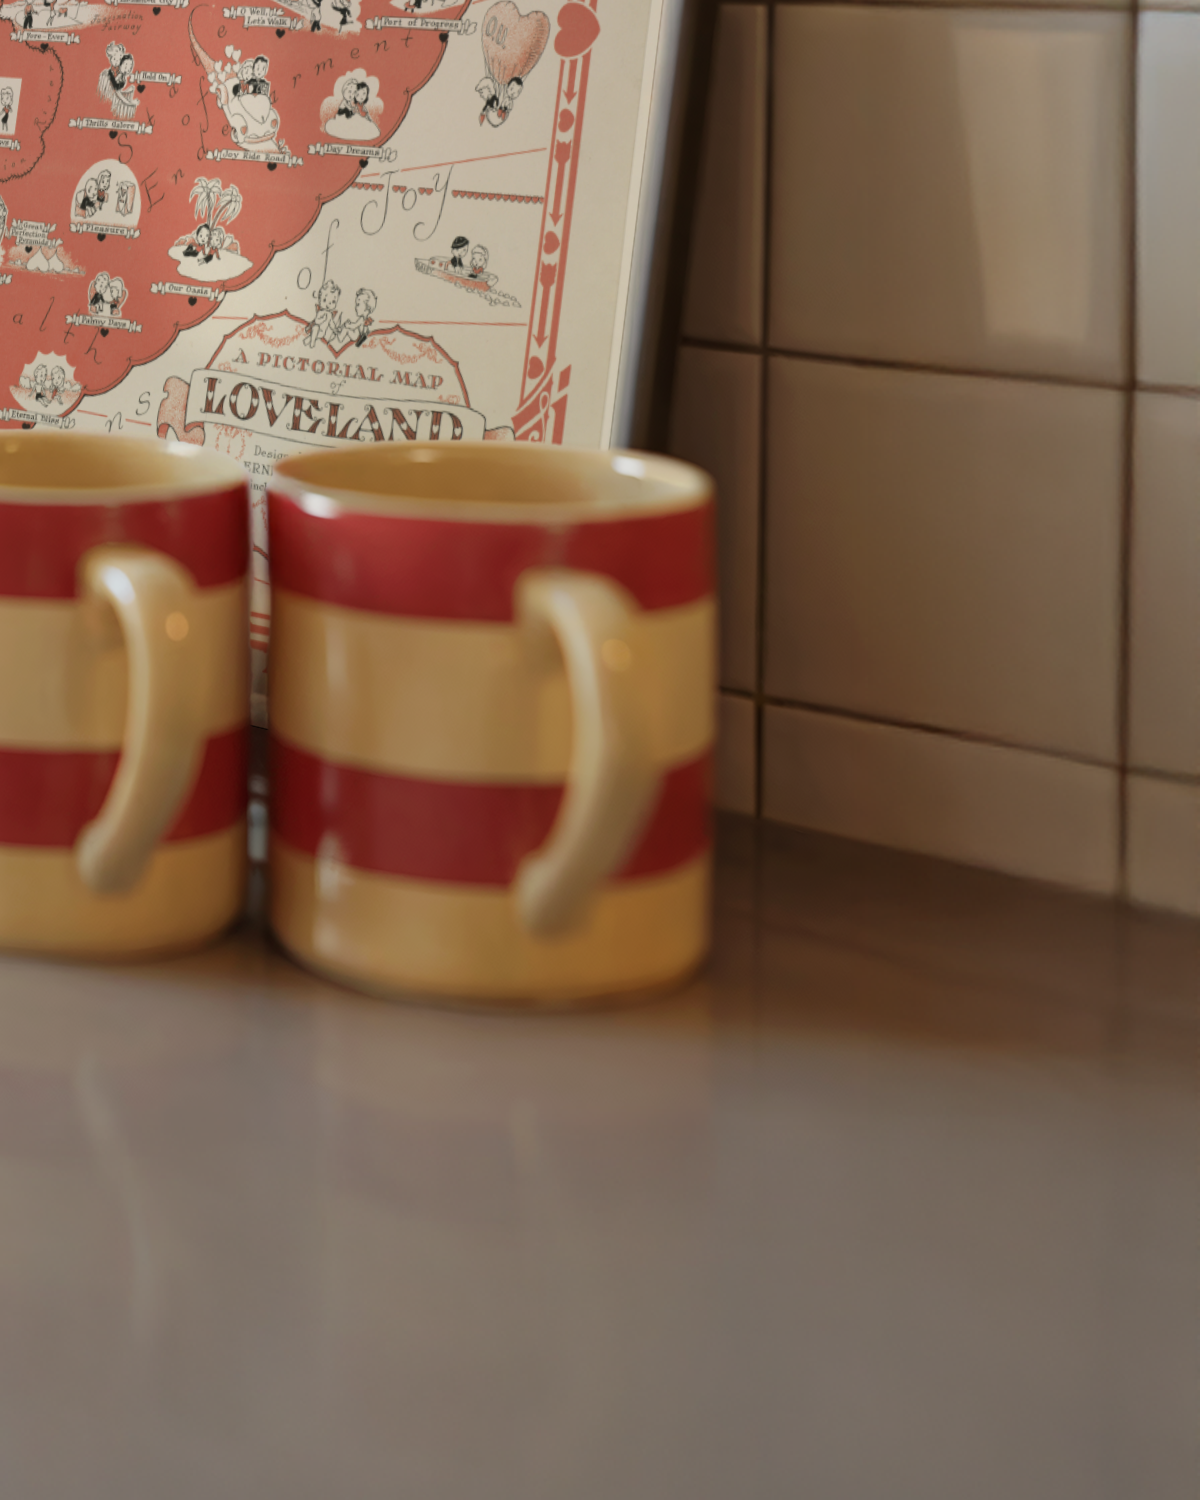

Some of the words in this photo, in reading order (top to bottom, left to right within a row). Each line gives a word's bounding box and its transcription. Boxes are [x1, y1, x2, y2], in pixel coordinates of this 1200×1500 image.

[91, 13, 144, 25] Fascination
[247, 17, 265, 25] Let's
[267, 18, 287, 26] Walk
[384, 18, 404, 27] Port
[408, 19, 418, 27] of
[421, 20, 459, 31] Progress
[101, 22, 142, 35] Fairway
[181, 75, 209, 134] of
[326, 144, 342, 153] Day
[347, 146, 380, 156] Dreams
[222, 152, 239, 160] Joy
[243, 152, 262, 160] Ride
[265, 154, 286, 163] Road
[361, 164, 454, 242] Joy
[23, 222, 44, 230] Great
[86, 224, 125, 234] Pleasure
[11, 229, 47, 238] Perfection
[18, 237, 49, 246] Pyramids
[168, 284, 184, 292] Our
[186, 286, 208, 295] Oasis
[81, 317, 106, 326] Palmy
[109, 319, 127, 328] Days
[232, 348, 249, 364] A
[257, 352, 384, 382] PICTORIAL
[389, 371, 444, 390] MAP
[330, 380, 346, 395] of
[201, 377, 463, 442] LOVELAND
[11, 411, 37, 420] Eternal
[41, 415, 60, 424] Bliss
